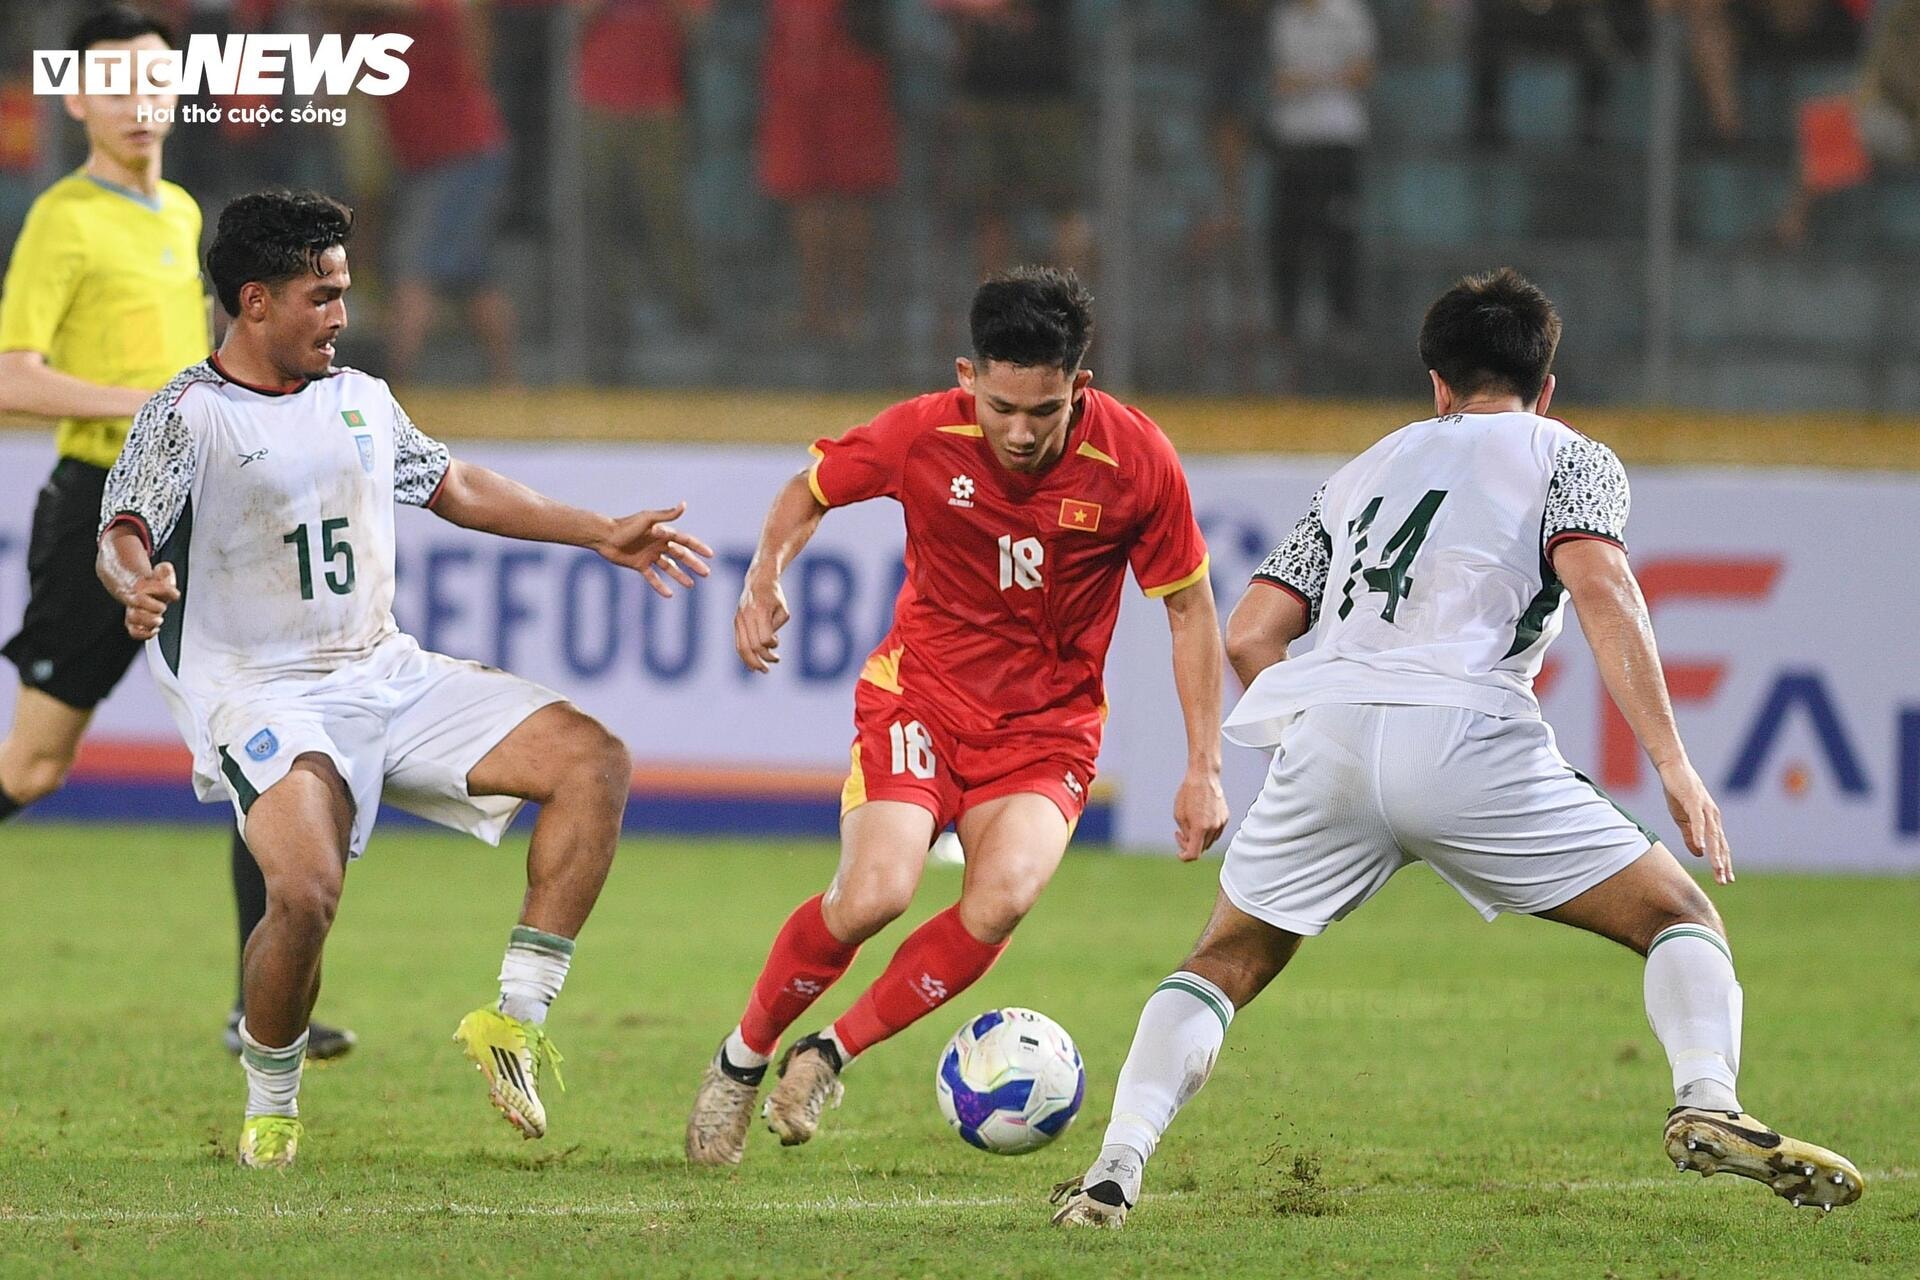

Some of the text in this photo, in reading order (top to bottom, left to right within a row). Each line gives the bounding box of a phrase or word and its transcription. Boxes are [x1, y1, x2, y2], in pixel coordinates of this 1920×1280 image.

[283, 517, 355, 600] 15
[998, 534, 1044, 592] 18
[1338, 489, 1448, 623] 14
[889, 719, 937, 780] 18
